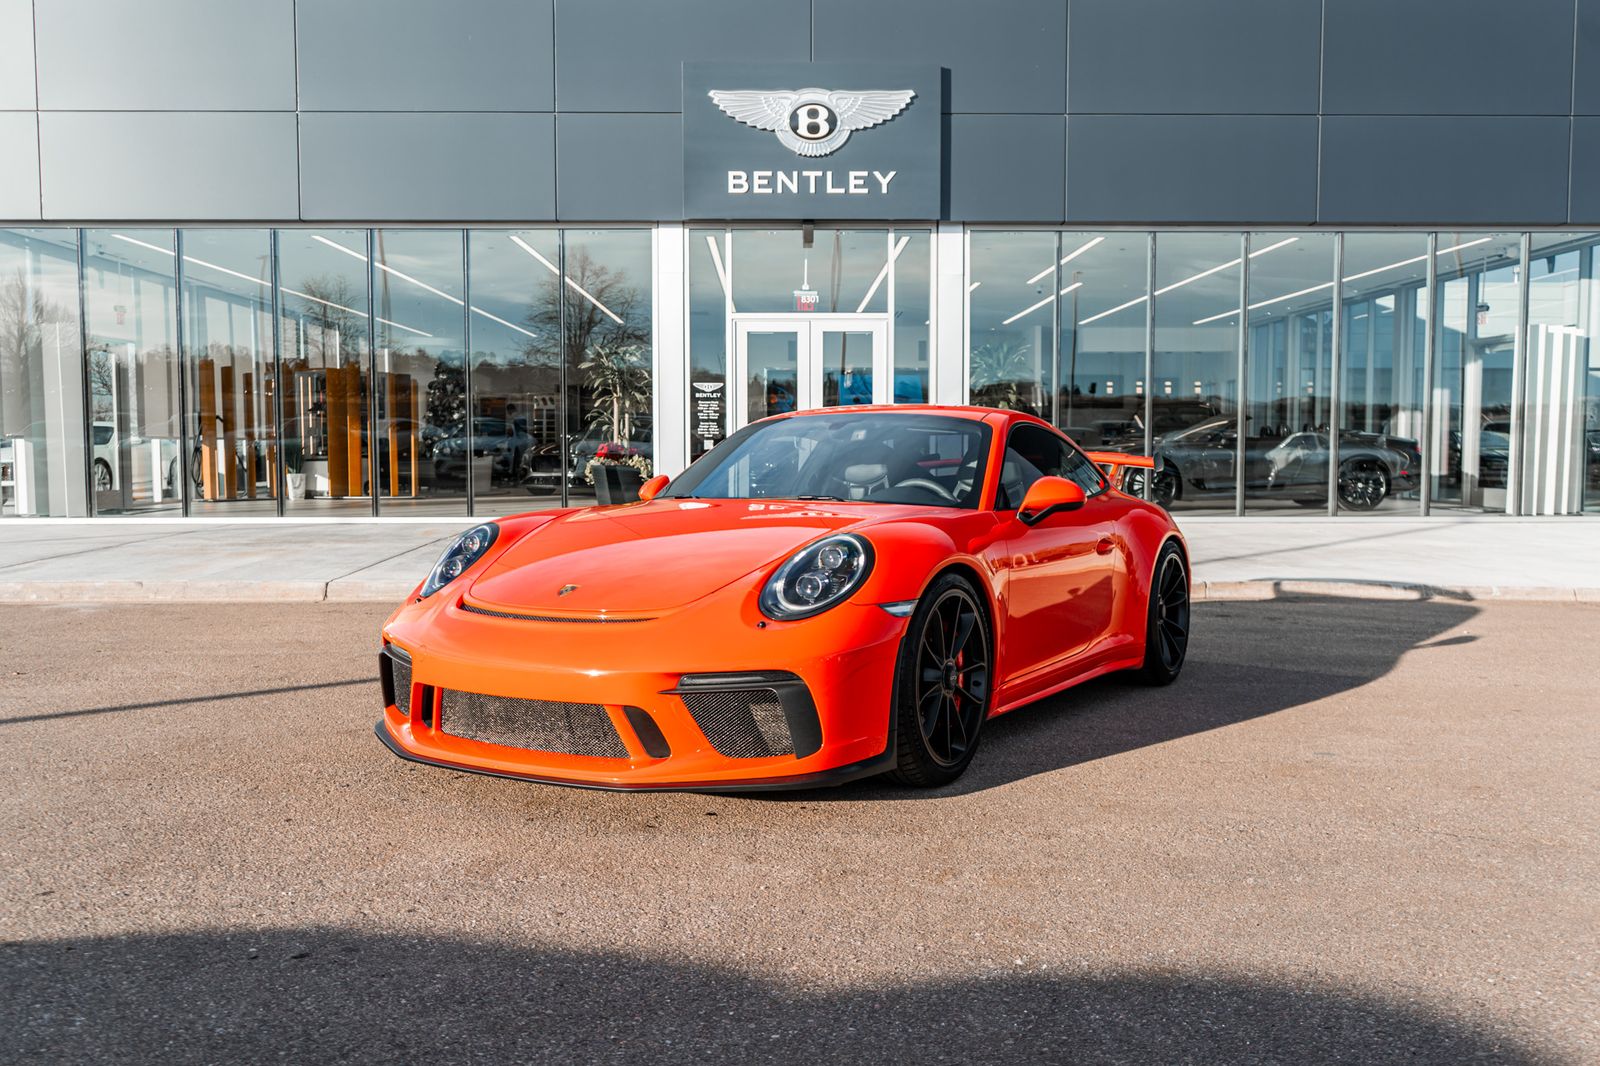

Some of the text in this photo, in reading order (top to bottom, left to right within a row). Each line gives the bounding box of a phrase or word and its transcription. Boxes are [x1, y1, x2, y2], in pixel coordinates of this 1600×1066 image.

[796, 104, 830, 138] B
[727, 170, 897, 194] BENTLEY
[801, 296, 820, 304] 8301
